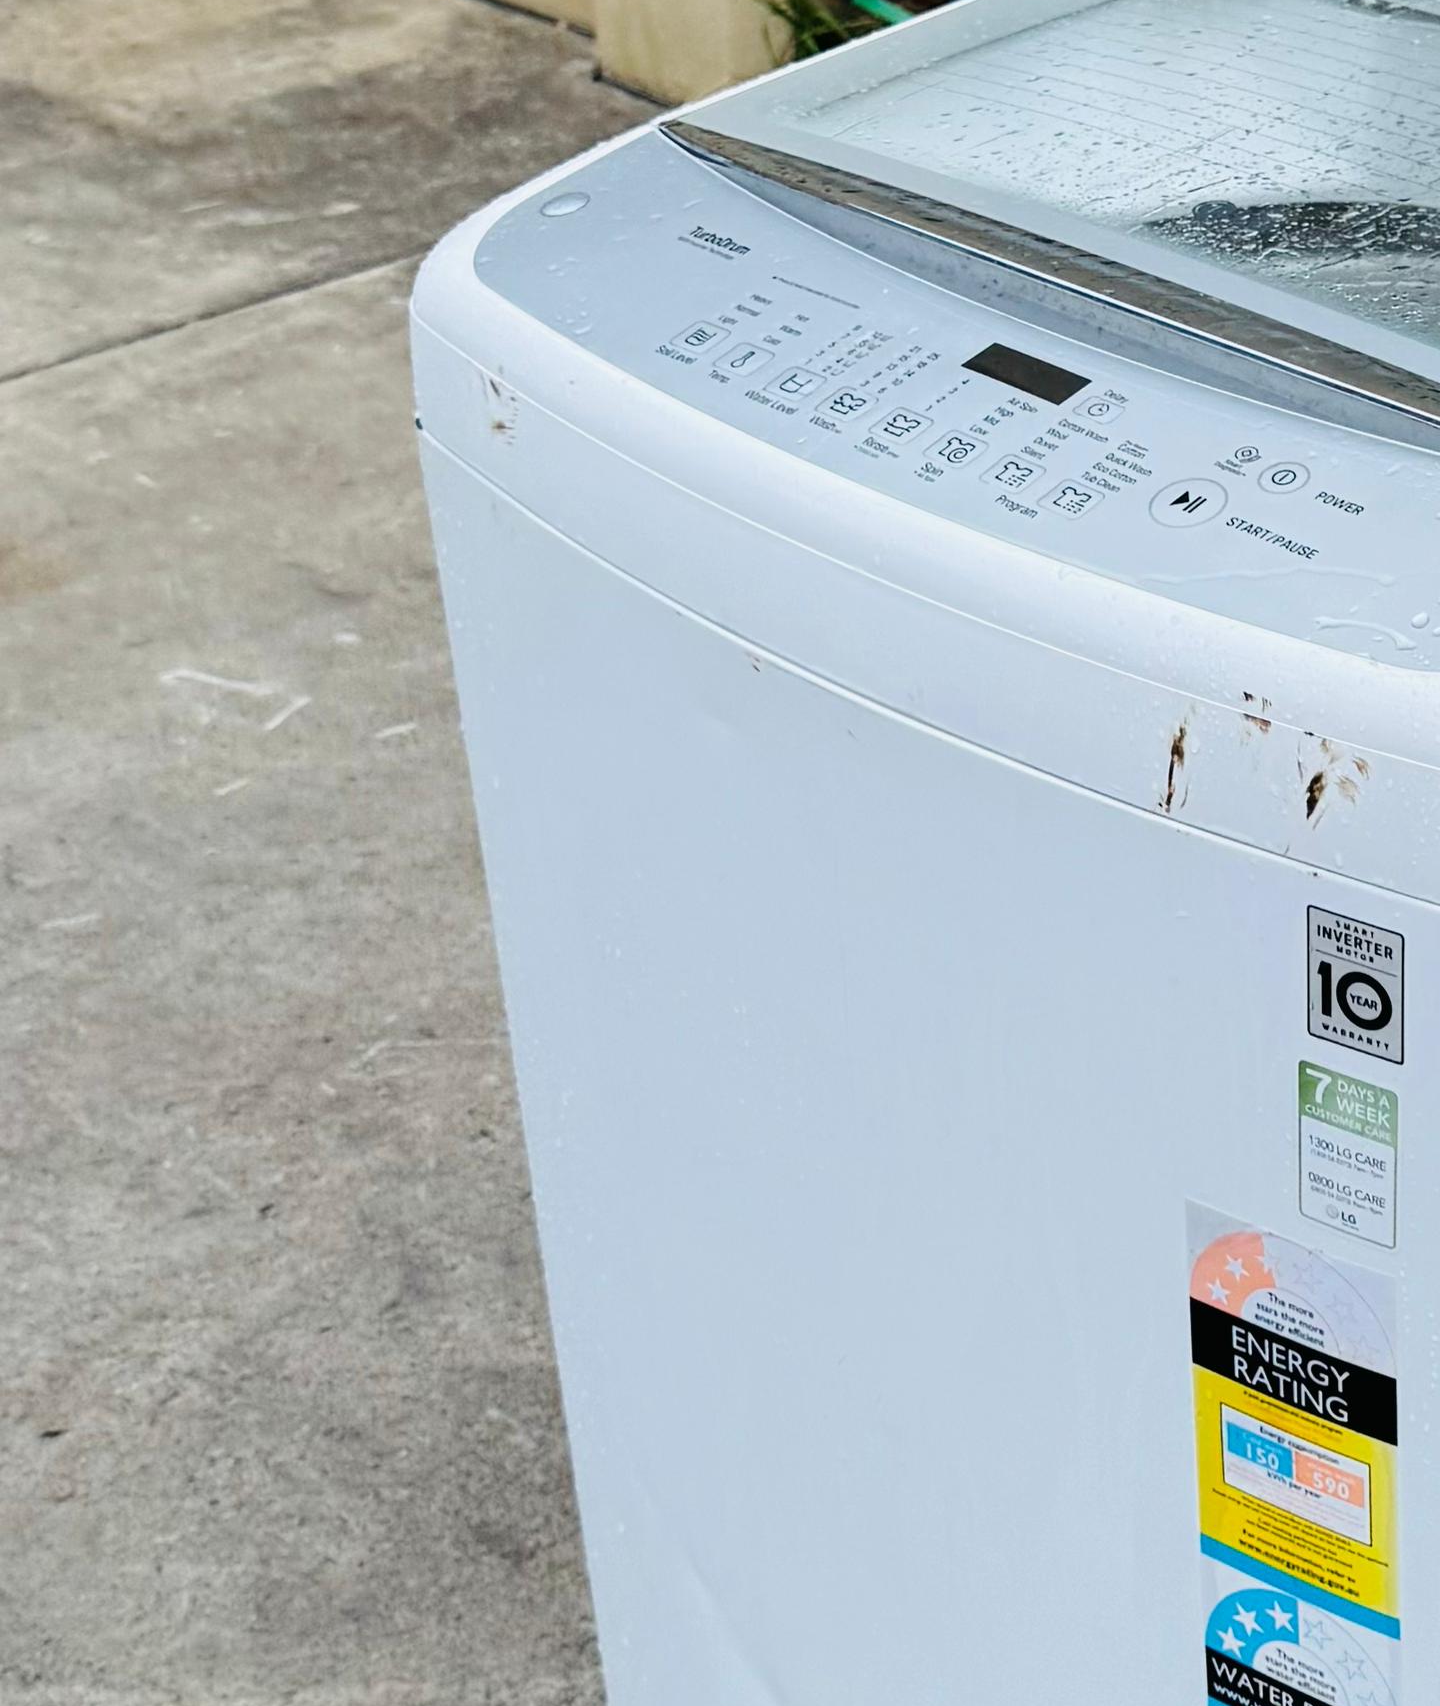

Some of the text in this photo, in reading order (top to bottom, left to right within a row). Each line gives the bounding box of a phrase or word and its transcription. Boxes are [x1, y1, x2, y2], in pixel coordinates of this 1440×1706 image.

[690, 226, 751, 255] TurboDrum
[744, 389, 800, 416] Water Level
[920, 461, 945, 477] Spin
[1092, 461, 1137, 485] Eco Cotton
[1105, 452, 1153, 477] Quick Wash
[1081, 471, 1121, 493] Tub Clean
[994, 494, 1039, 519] Program
[1315, 491, 1365, 516] POWER
[1226, 516, 1320, 560] START/PAUSE
[1317, 924, 1393, 960] INVERTER
[1335, 919, 1375, 939] SMART
[1336, 945, 1374, 964] MOTOR
[1317, 960, 1393, 1031] 10
[1350, 992, 1379, 1012] YEAR
[1321, 1022, 1389, 1052] WARRANTY
[1305, 1068, 1391, 1110] 7 DAYS A
[1305, 1104, 1392, 1143] CUSTOMER CARE
[1336, 1095, 1391, 1129] WEEK
[1308, 1134, 1334, 1154] 1300
[1336, 1144, 1352, 1160] LG
[1355, 1152, 1386, 1172] CARE
[1336, 1182, 1352, 1197] LG
[1355, 1189, 1386, 1209] CARE
[1341, 1210, 1357, 1226] LG
[1256, 1302, 1325, 1336] stars the more
[1267, 1291, 1315, 1320] The more
[1254, 1313, 1325, 1349] energy efficient
[1231, 1324, 1351, 1394] ENERGY
[1233, 1354, 1349, 1423] RATING
[1245, 1442, 1280, 1471] 150
[1311, 1469, 1350, 1501] 590
[1265, 1654, 1337, 1693] stars the more
[1266, 1666, 1294, 1686] water
[1276, 1647, 1325, 1679] The more
